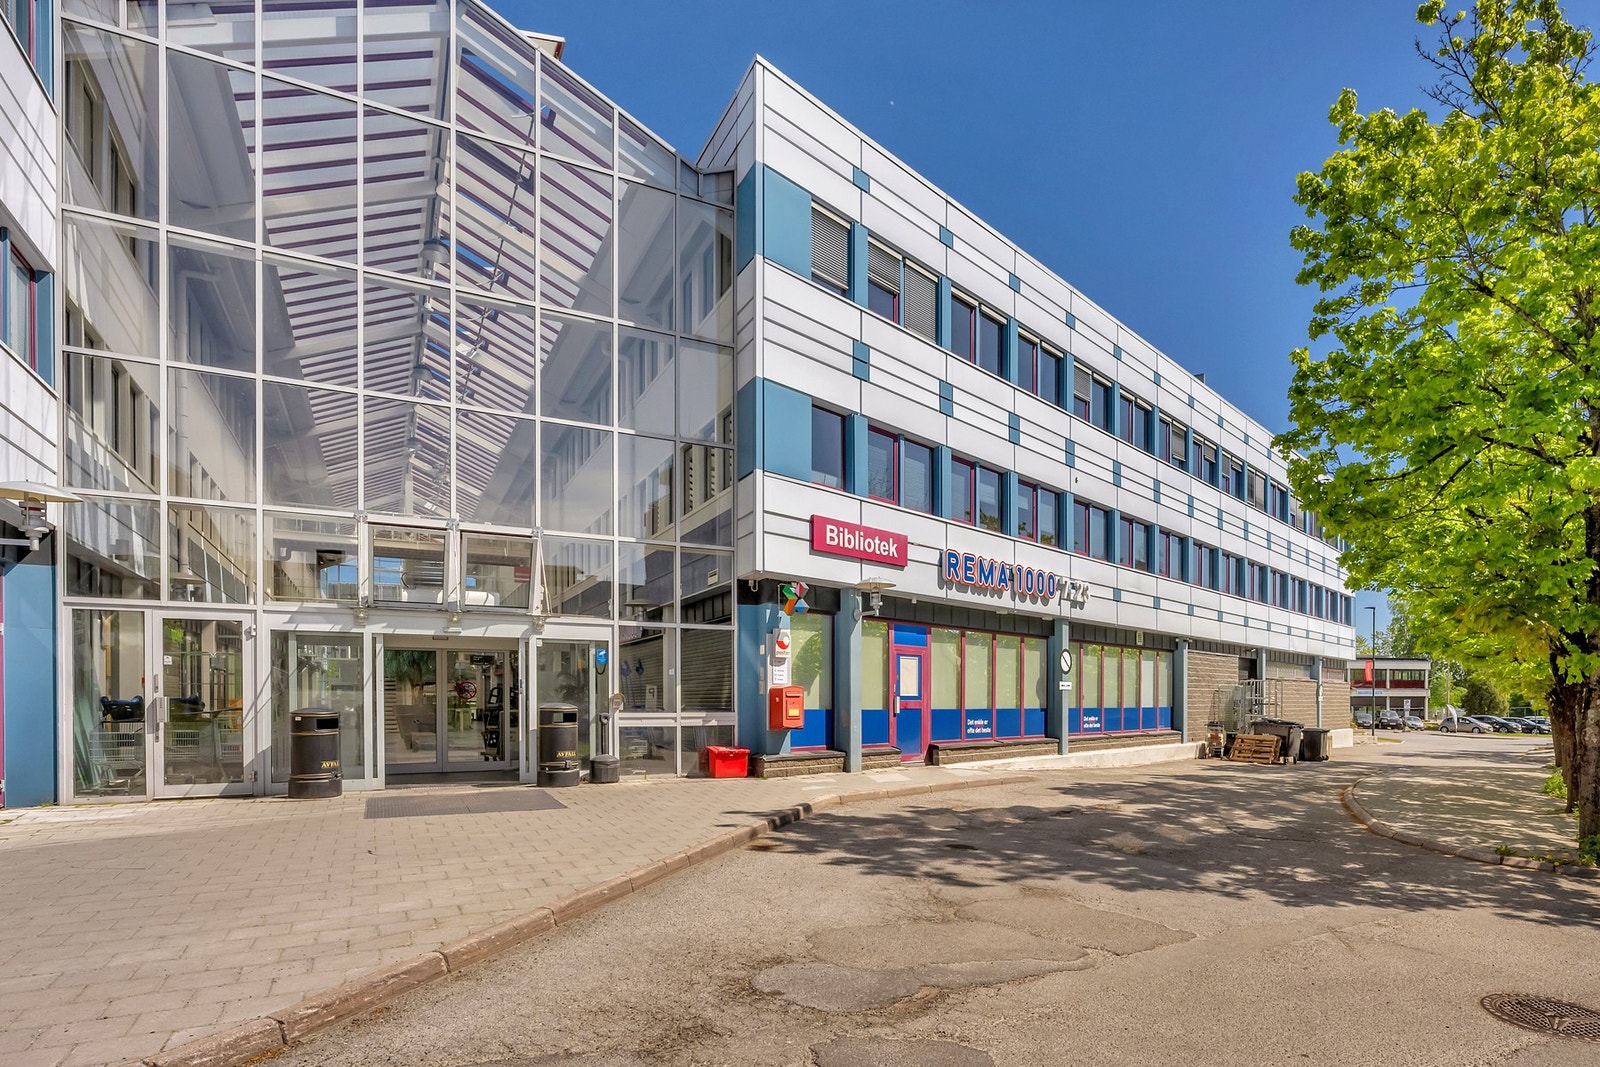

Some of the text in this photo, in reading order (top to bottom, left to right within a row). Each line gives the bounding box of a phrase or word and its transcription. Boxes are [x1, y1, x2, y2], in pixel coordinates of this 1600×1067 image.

[826, 524, 898, 558] Bibliotek
[945, 548, 1009, 591] REMA
[1015, 564, 1056, 599] 1000
